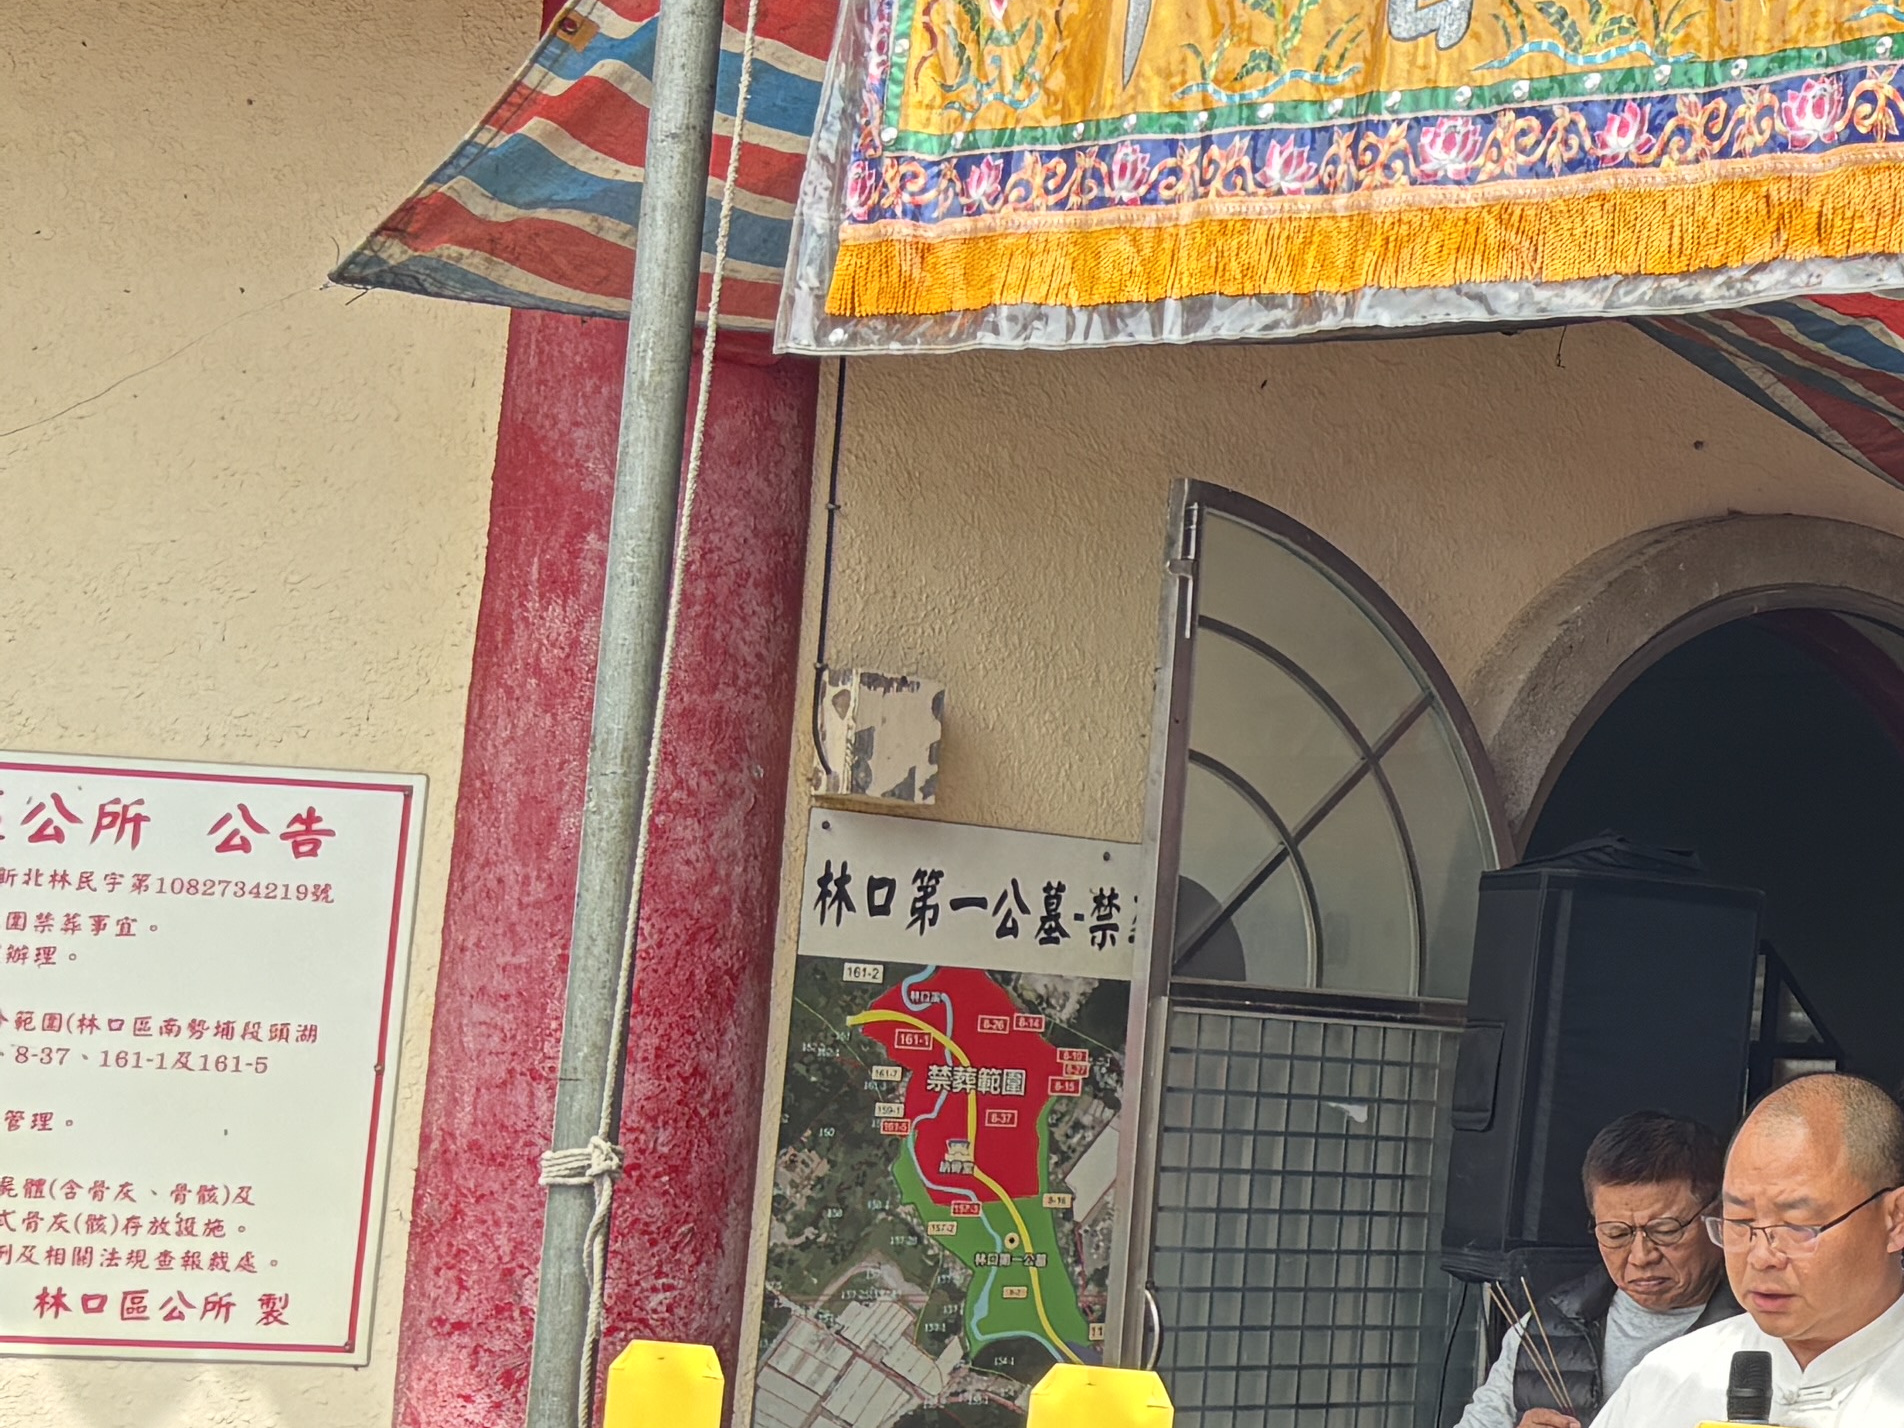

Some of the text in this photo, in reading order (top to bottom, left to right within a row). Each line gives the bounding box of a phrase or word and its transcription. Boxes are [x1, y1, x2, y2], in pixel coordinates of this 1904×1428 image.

[0, 791, 336, 860] 公所 公告
[847, 966, 880, 980] 161-2
[899, 1033, 930, 1046] 161-1
[927, 1065, 1026, 1096] 禁葬範圍
[33, 1286, 290, 1326] 林口區公所 製
